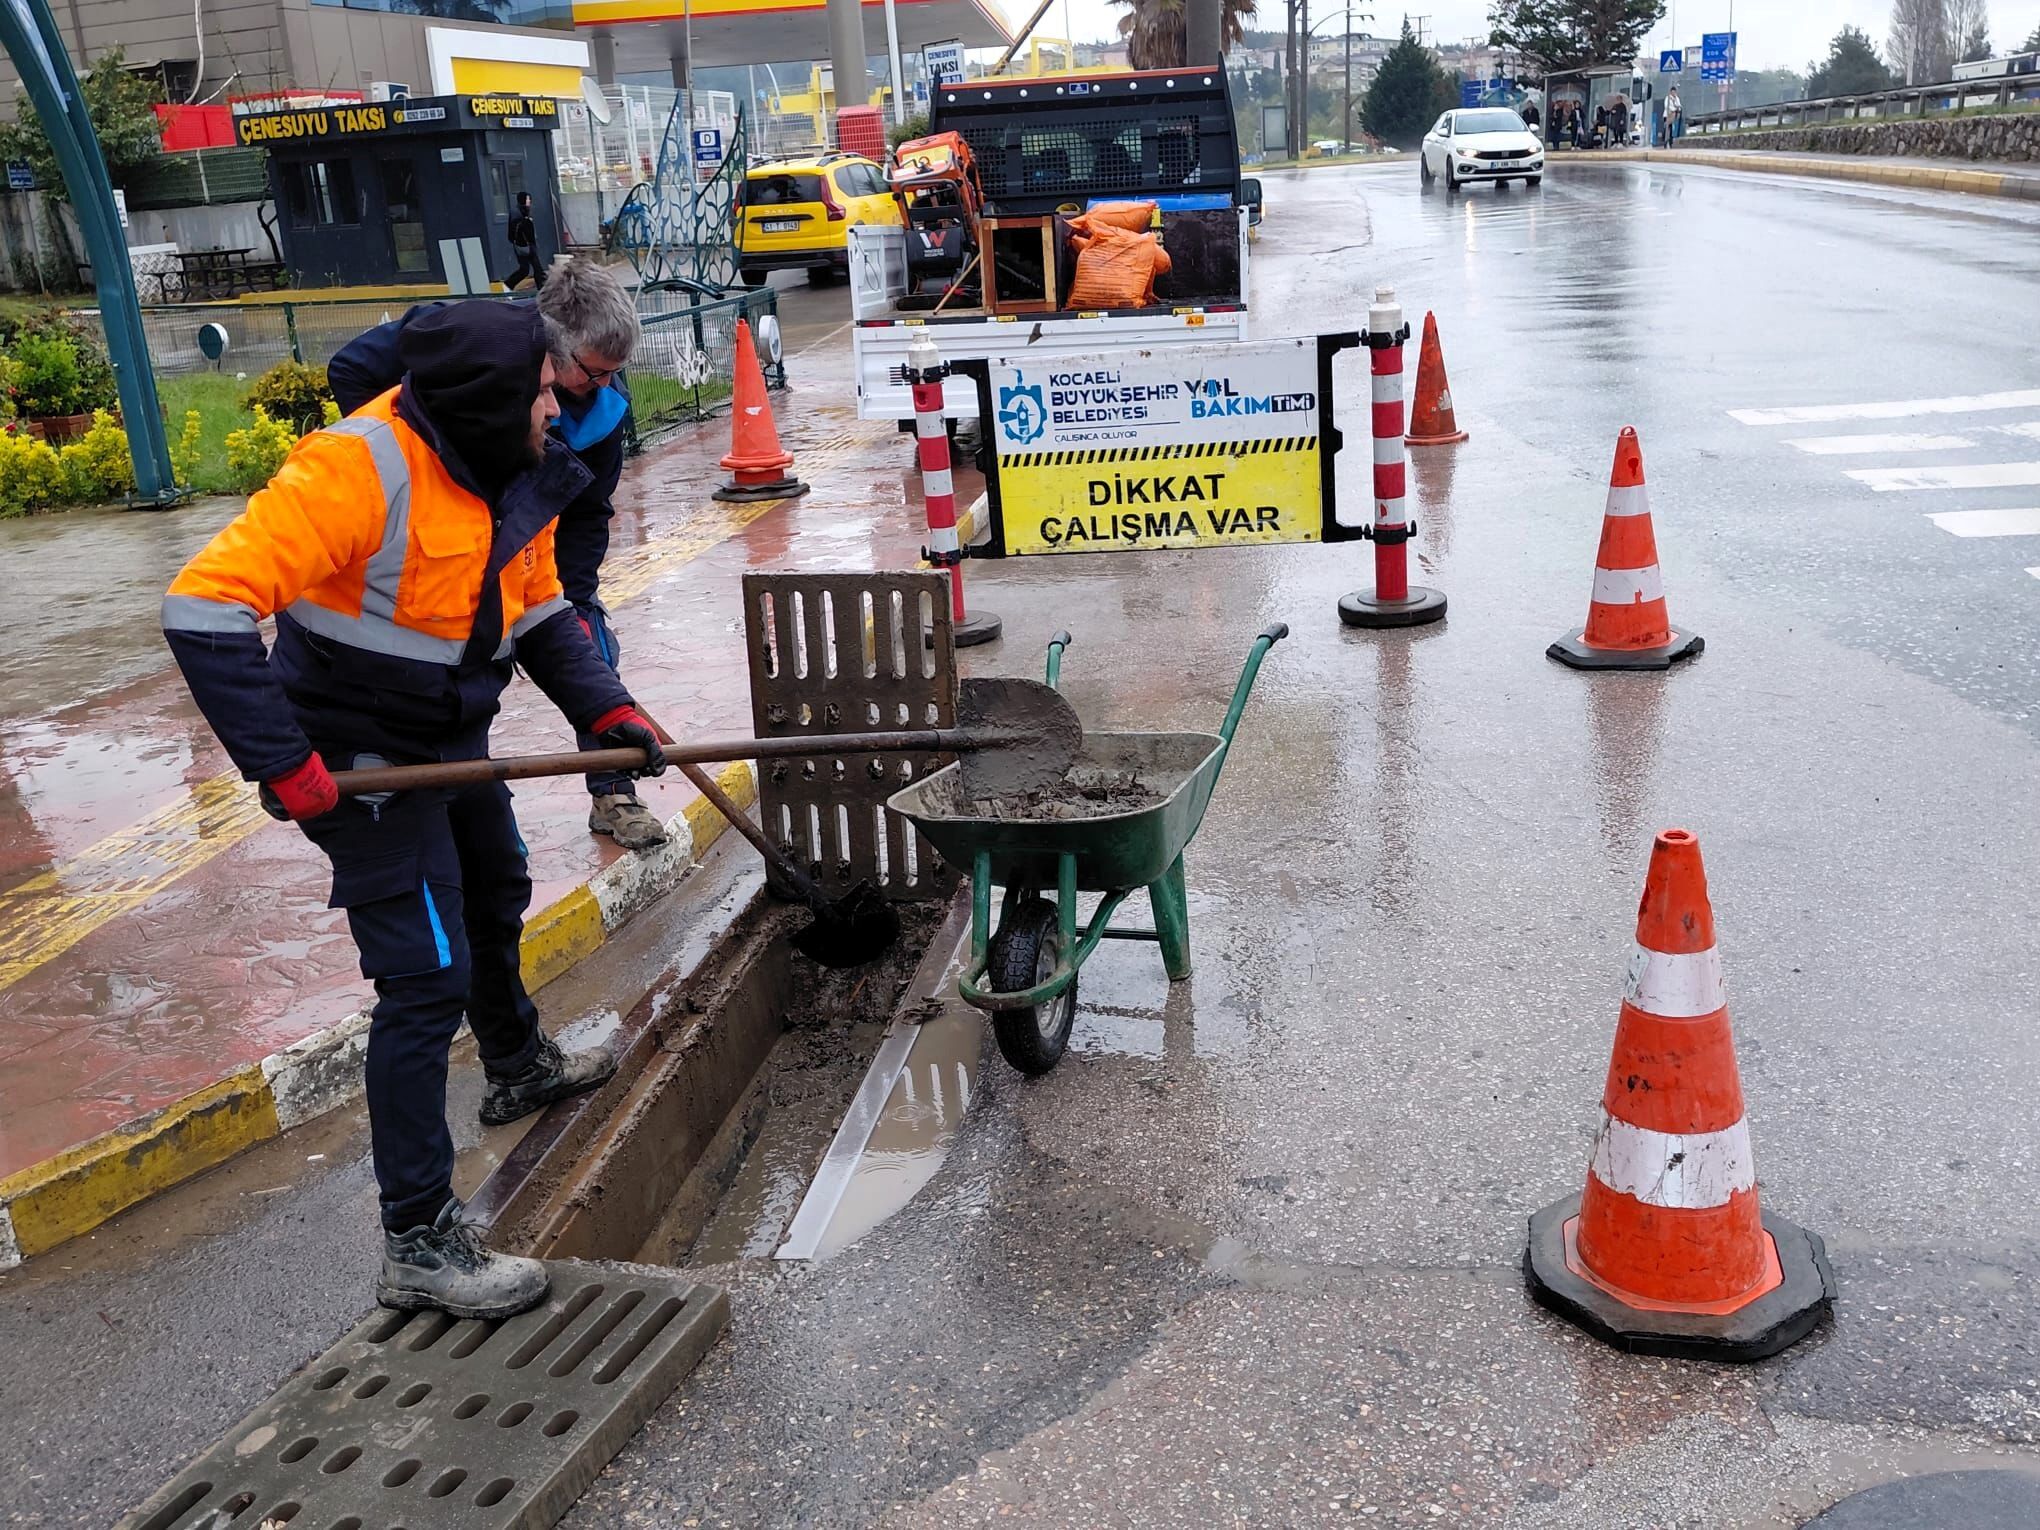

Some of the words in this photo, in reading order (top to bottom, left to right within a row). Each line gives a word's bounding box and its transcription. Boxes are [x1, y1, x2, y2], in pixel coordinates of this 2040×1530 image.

[471, 98, 523, 117] ÇENESUYU
[239, 112, 328, 145] ÇENESUYU
[704, 134, 711, 144] D
[1191, 396, 1271, 418] BAKIM
[1101, 430, 1138, 439] OLUYOR
[1088, 473, 1225, 506] DİKKAT
[1040, 511, 1200, 548] ÇALIŞMA
[1207, 506, 1281, 534] VAR
